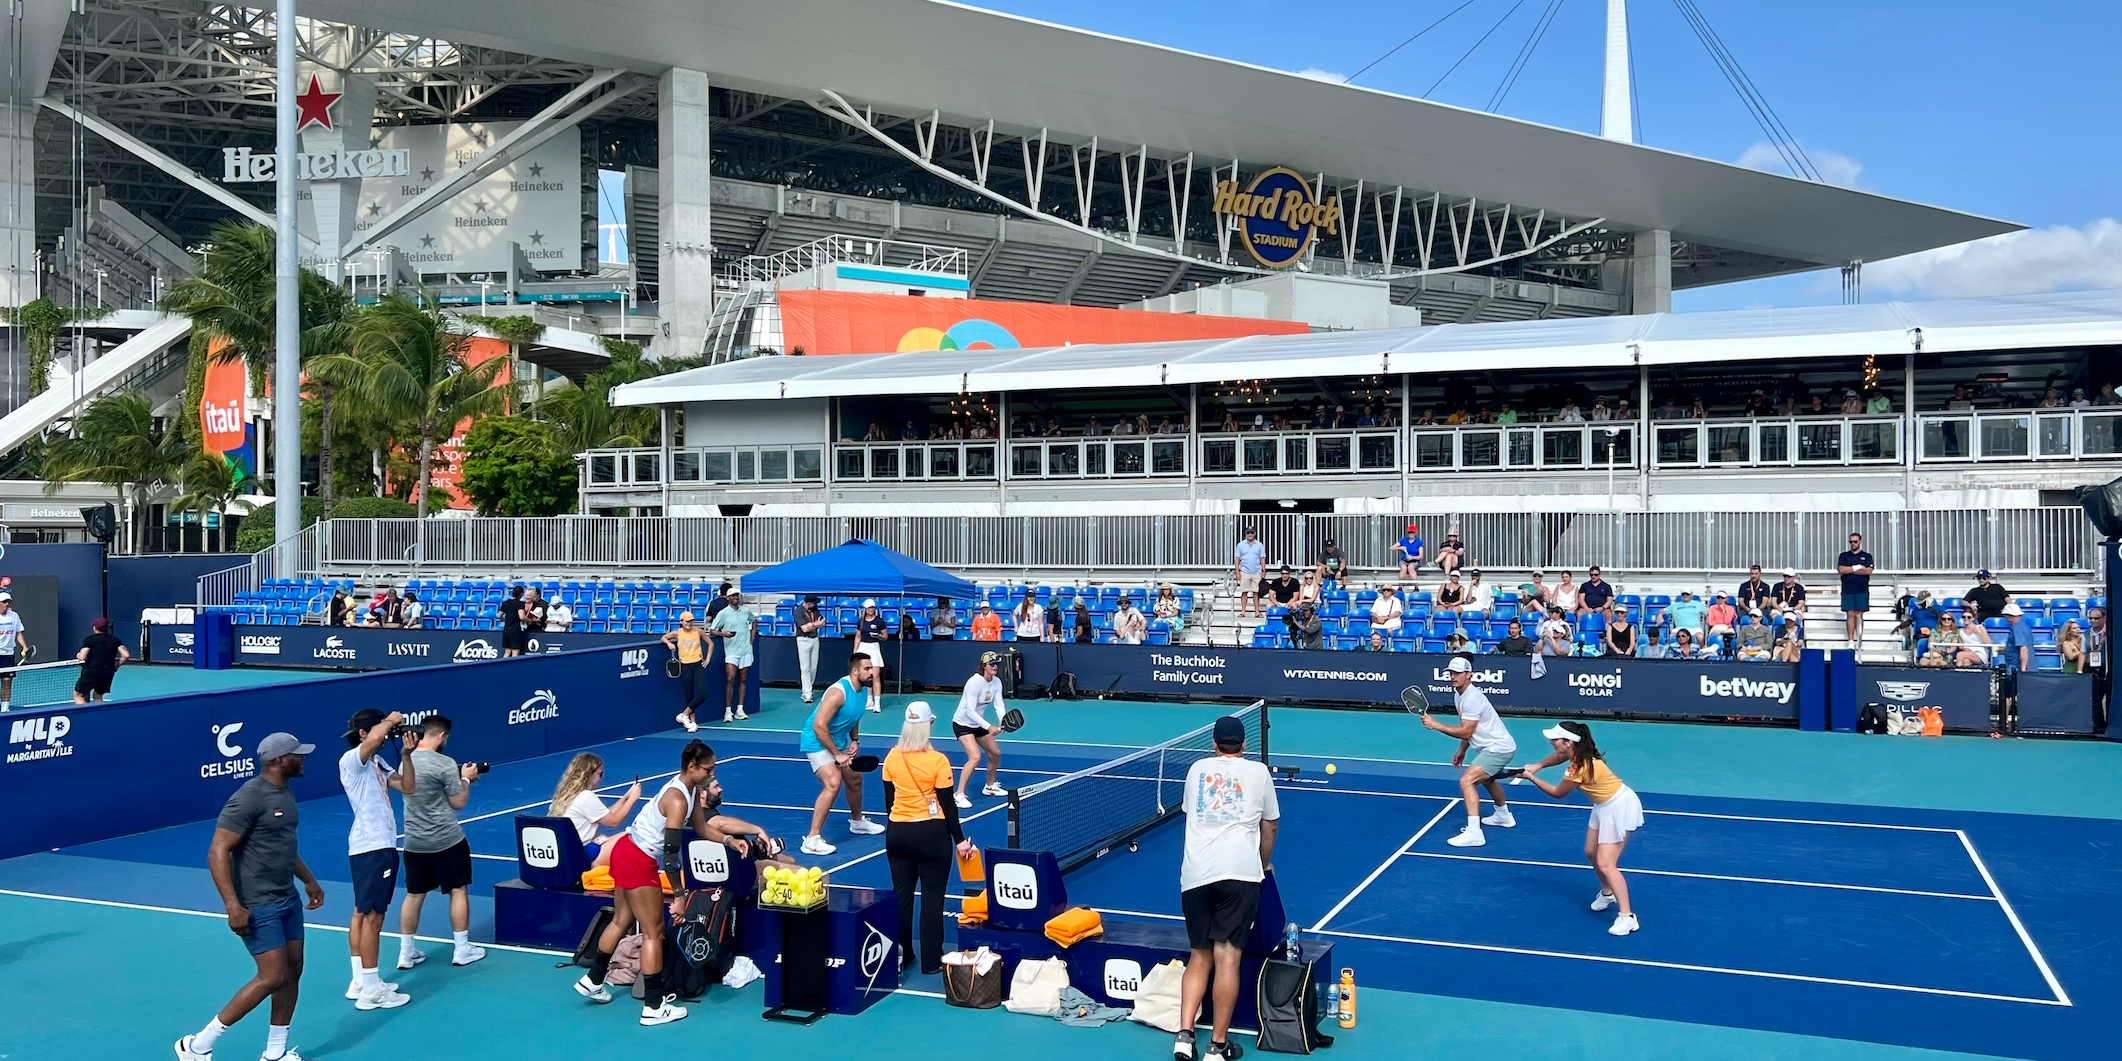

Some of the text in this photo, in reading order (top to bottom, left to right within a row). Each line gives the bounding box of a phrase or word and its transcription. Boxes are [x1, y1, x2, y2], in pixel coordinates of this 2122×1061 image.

[222, 144, 408, 183] Heneken
[510, 181, 564, 192] Heineken
[1212, 180, 1341, 235] Hard Rock
[454, 217, 508, 228] Heineken
[1253, 233, 1299, 249] STADIUM
[524, 249, 564, 259] ineken
[30, 509, 80, 518] Heineken
[241, 636, 280, 647] HOLOGIC
[313, 648, 356, 659] LACOSTE
[388, 643, 430, 656] LASVIT
[453, 638, 498, 659] Acordis
[1151, 654, 1226, 668] The Buchholz
[1153, 670, 1224, 685] Family Court
[1283, 669, 1387, 682] WTATENNIS.COM
[1433, 667, 1503, 683] Laold
[1428, 685, 1452, 693] Tennis
[1579, 688, 1613, 697] SOLAR
[1700, 675, 1796, 704] betway
[508, 704, 558, 725] Electrolit
[9, 715, 71, 745] MLP
[200, 758, 254, 778] CELSIUS
[772, 887, 792, 900] X-40
